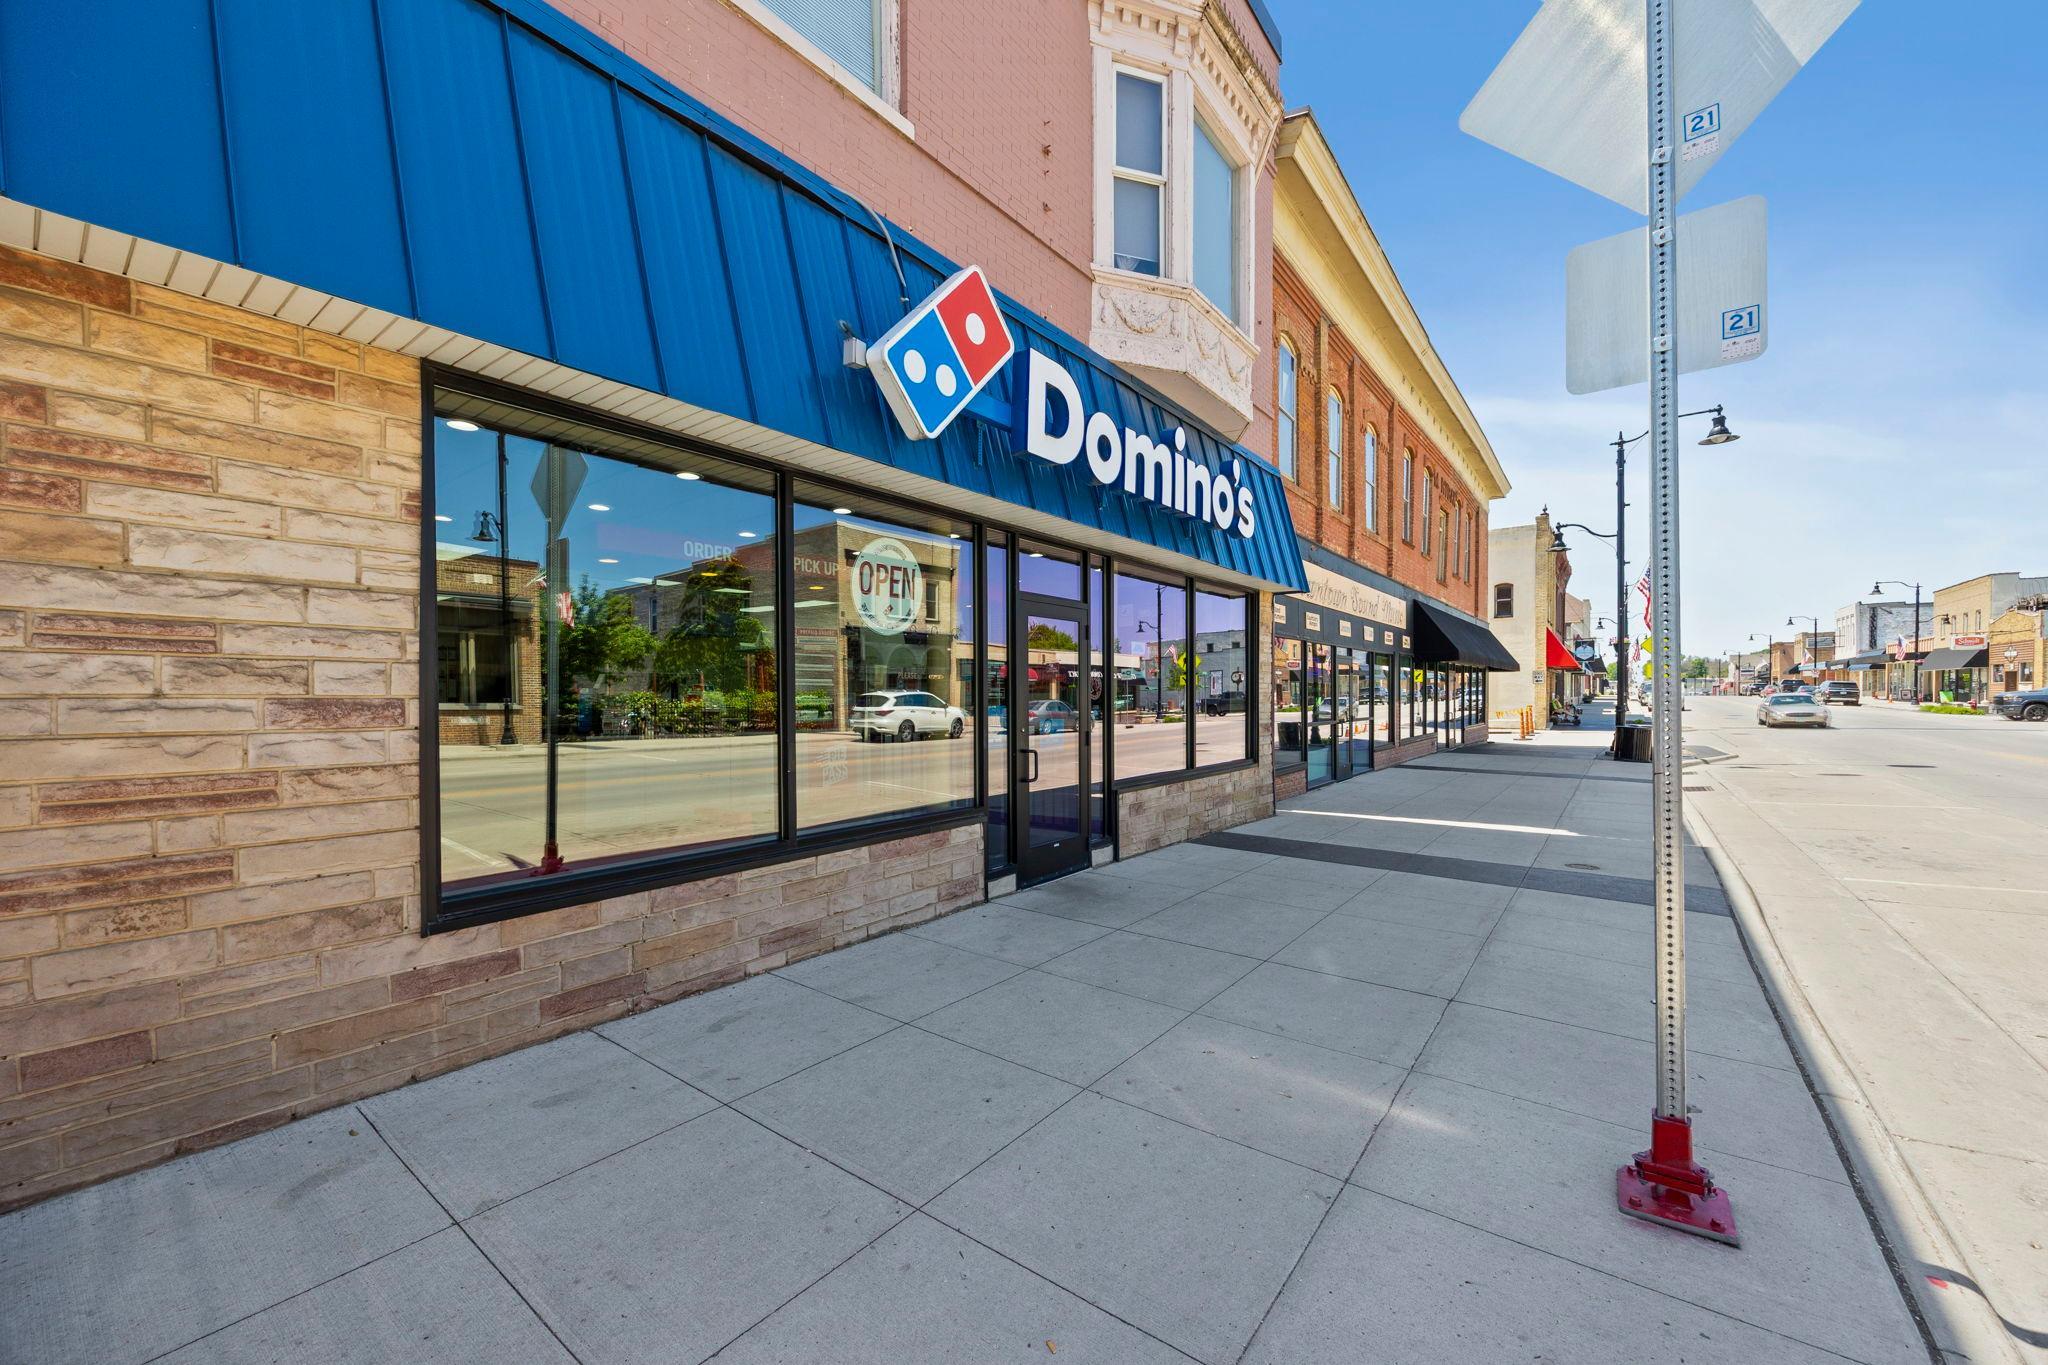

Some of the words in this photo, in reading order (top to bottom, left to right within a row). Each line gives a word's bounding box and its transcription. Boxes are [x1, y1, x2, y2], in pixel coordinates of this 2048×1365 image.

[1691, 110, 1714, 132] 21
[1729, 310, 1753, 331] 21
[1027, 347, 1255, 539] Domino's
[683, 540, 733, 562] ORDER
[793, 556, 819, 575] PICK
[823, 559, 839, 577] UP
[858, 559, 916, 601] OPEN
